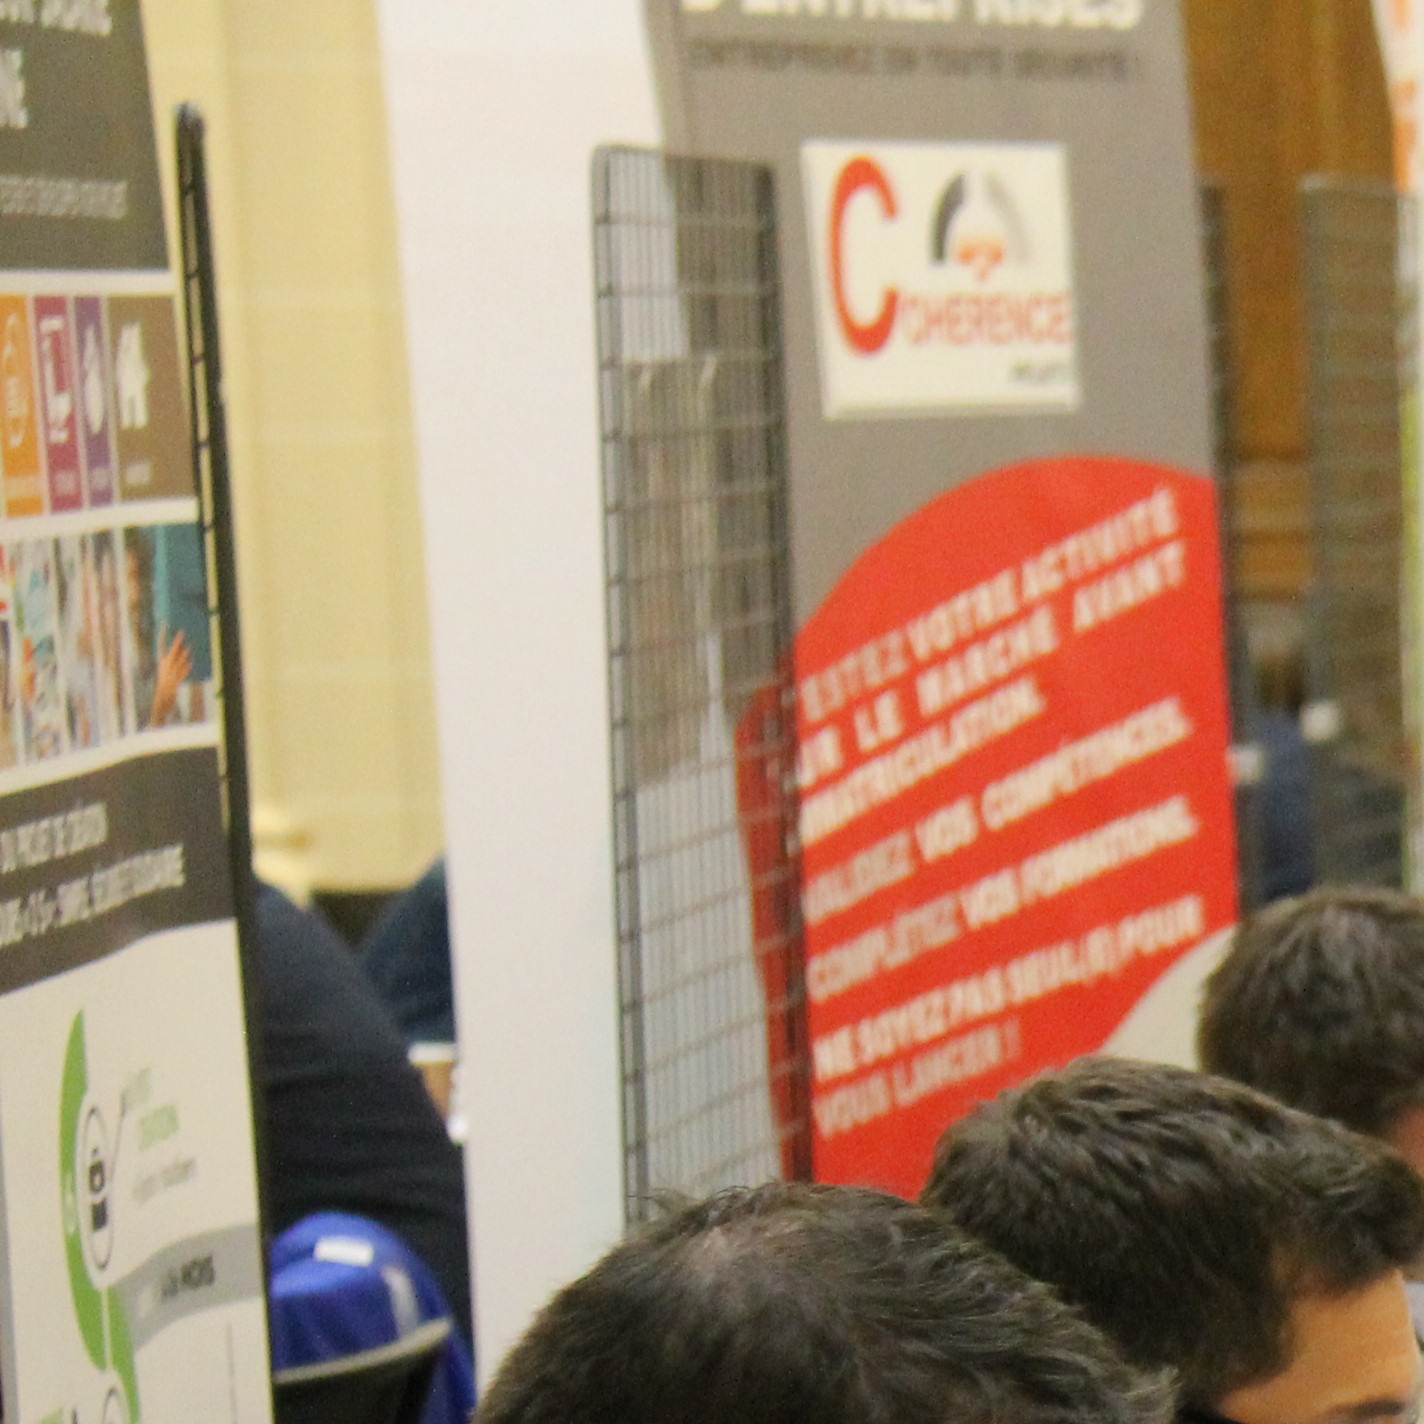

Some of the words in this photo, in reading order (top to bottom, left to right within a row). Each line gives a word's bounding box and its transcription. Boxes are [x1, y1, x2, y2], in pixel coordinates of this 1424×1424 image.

[853, 690, 904, 754] LE
[916, 602, 1060, 719] MARCHÉ
[1073, 539, 1186, 634] AVANT
[907, 568, 1019, 662] VOTRE
[1021, 482, 1180, 600] ACTIVITÉ
[916, 797, 979, 864] VOS
[959, 866, 1021, 932] VOS
[812, 1023, 857, 1084] NE
[857, 989, 946, 1066] SOYEZ
[948, 966, 1005, 1027] PAS
[1117, 894, 1204, 965] POUR
[812, 1065, 891, 1139] VOUS
[891, 1021, 1001, 1109] LANCER
